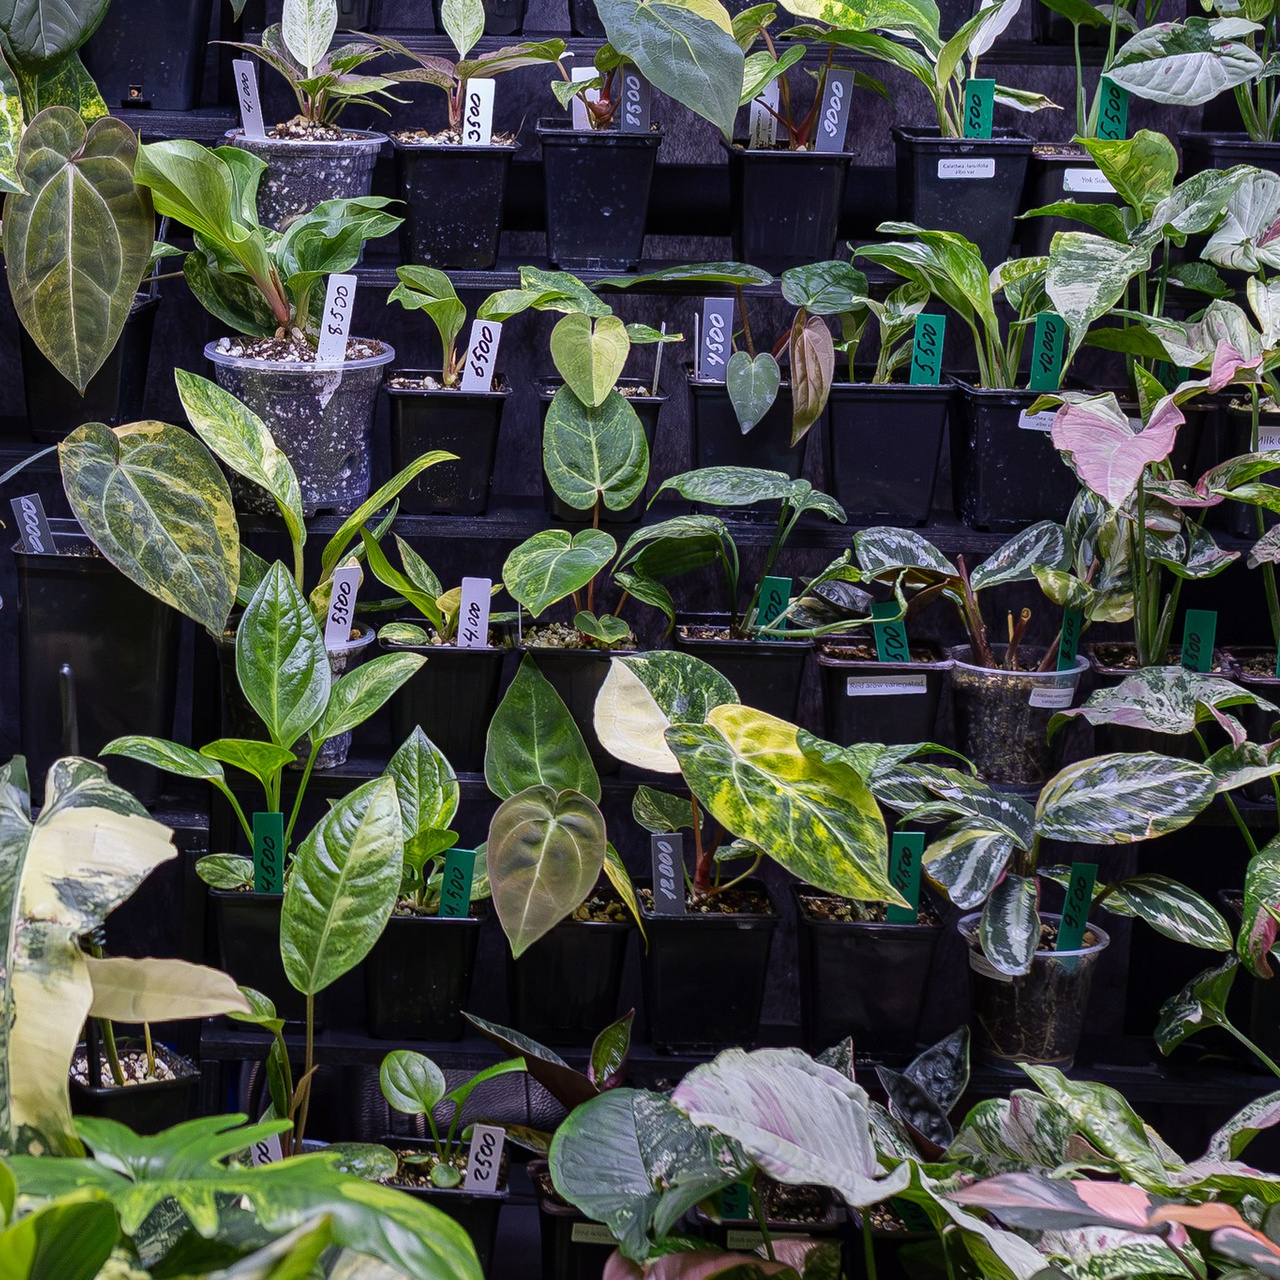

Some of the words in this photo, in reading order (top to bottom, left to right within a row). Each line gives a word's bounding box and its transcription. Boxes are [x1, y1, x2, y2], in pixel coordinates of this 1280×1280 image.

[466, 92, 482, 143] 3500
[823, 80, 844, 138] 9000
[327, 284, 349, 336] 8.500
[706, 312, 725, 367] 4500
[473, 1132, 496, 1181] 2500
